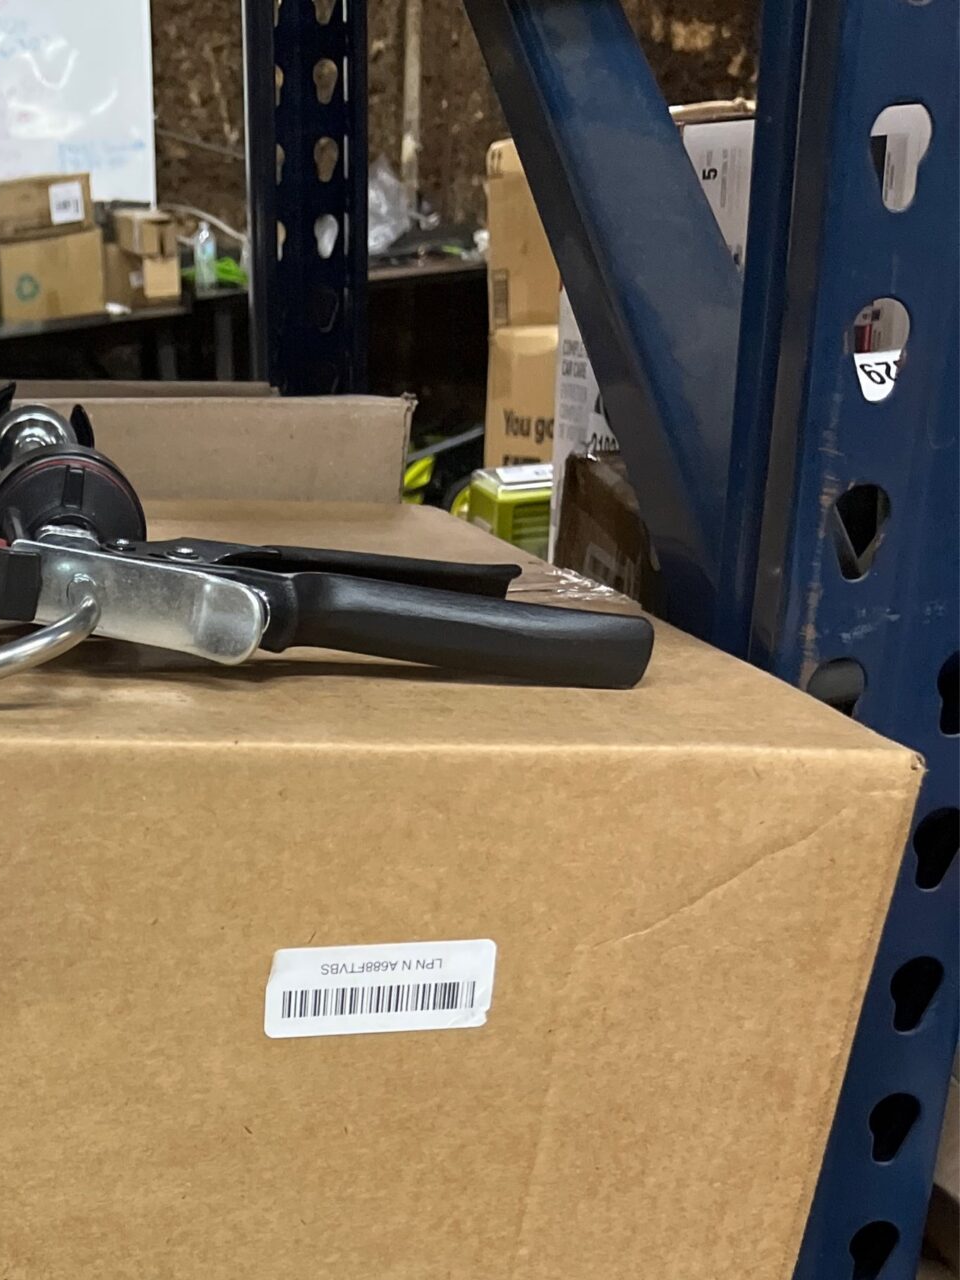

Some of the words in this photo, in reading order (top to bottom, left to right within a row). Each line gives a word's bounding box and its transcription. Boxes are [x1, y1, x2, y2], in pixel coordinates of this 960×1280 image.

[321, 961, 396, 975] A688FTVBS
[401, 960, 411, 970] N
[416, 958, 442, 970] LPN
